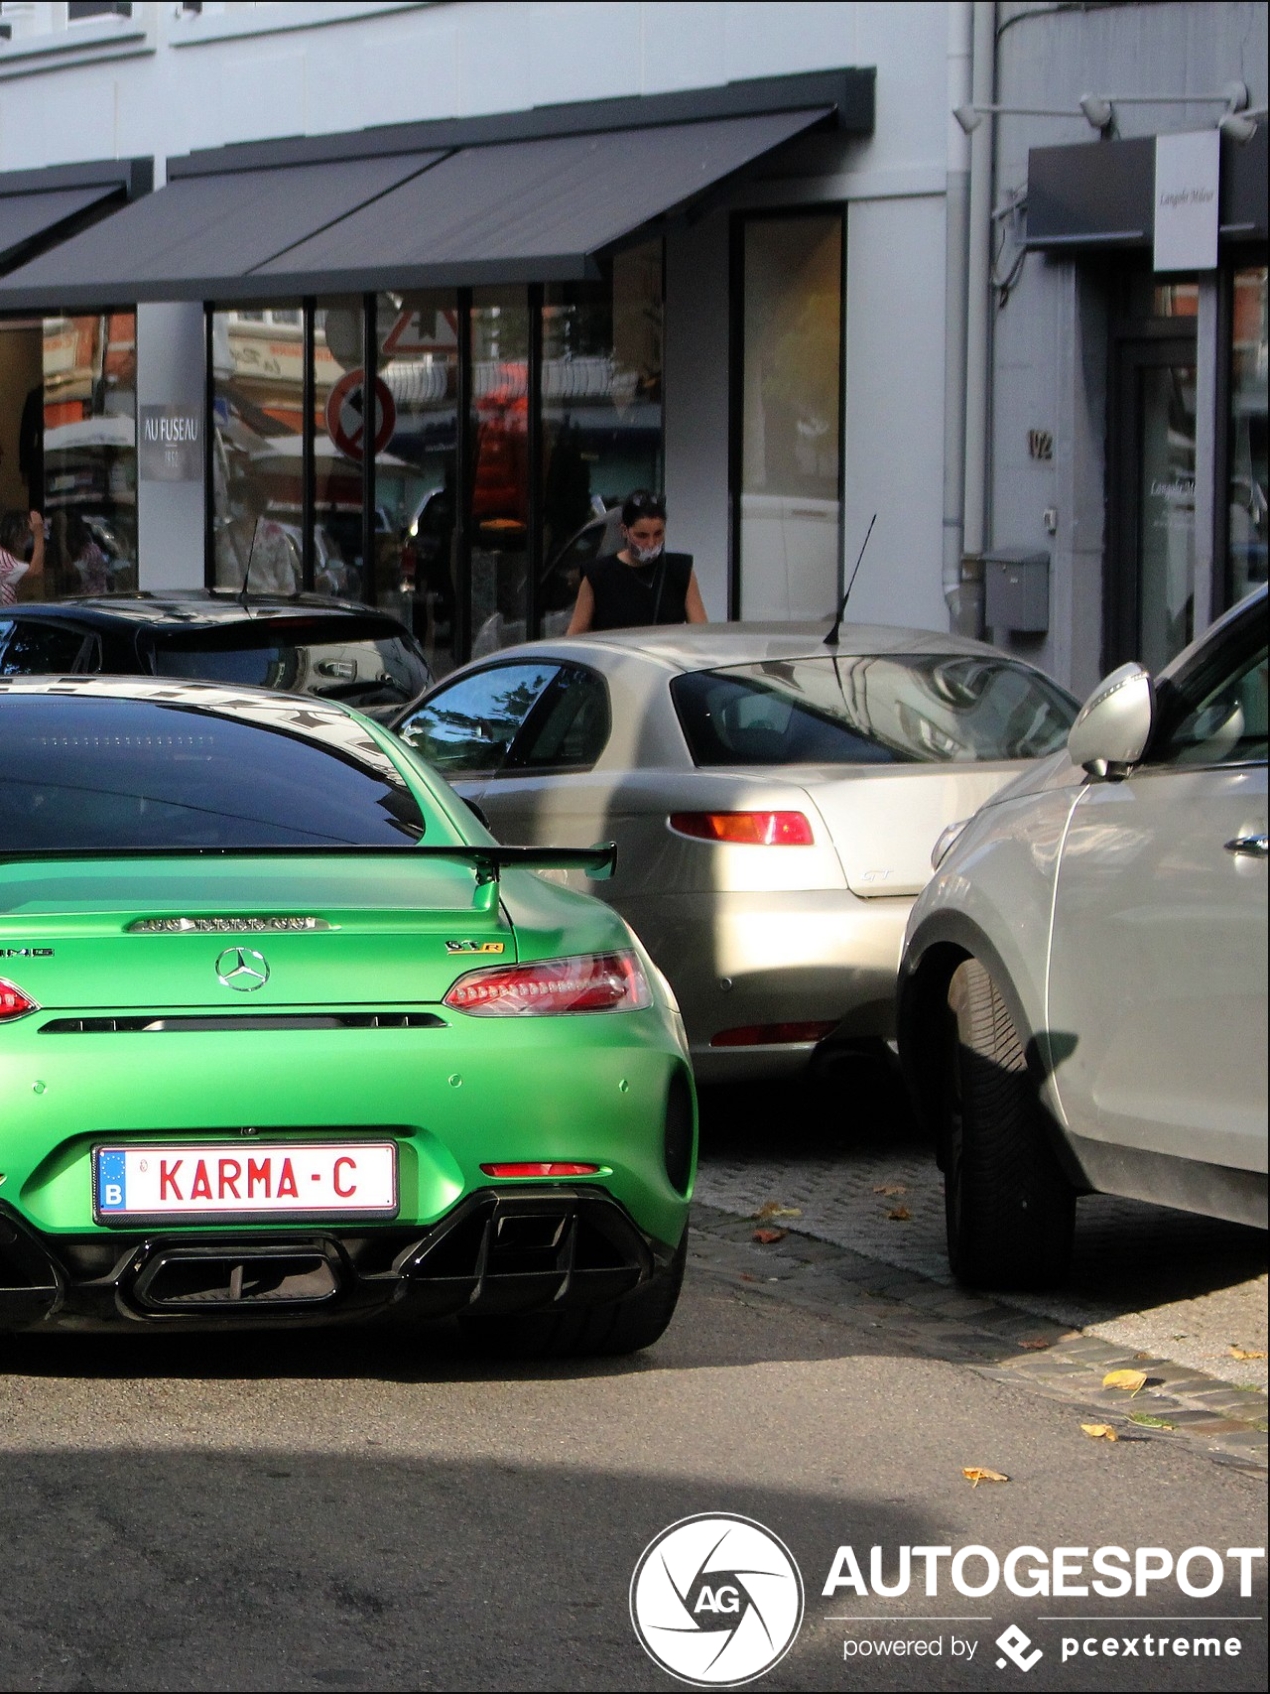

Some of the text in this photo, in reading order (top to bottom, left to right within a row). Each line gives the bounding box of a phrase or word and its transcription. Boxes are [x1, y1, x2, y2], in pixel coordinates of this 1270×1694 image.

[145, 417, 198, 441] AU FUSEAU
[105, 1184, 122, 1206] B
